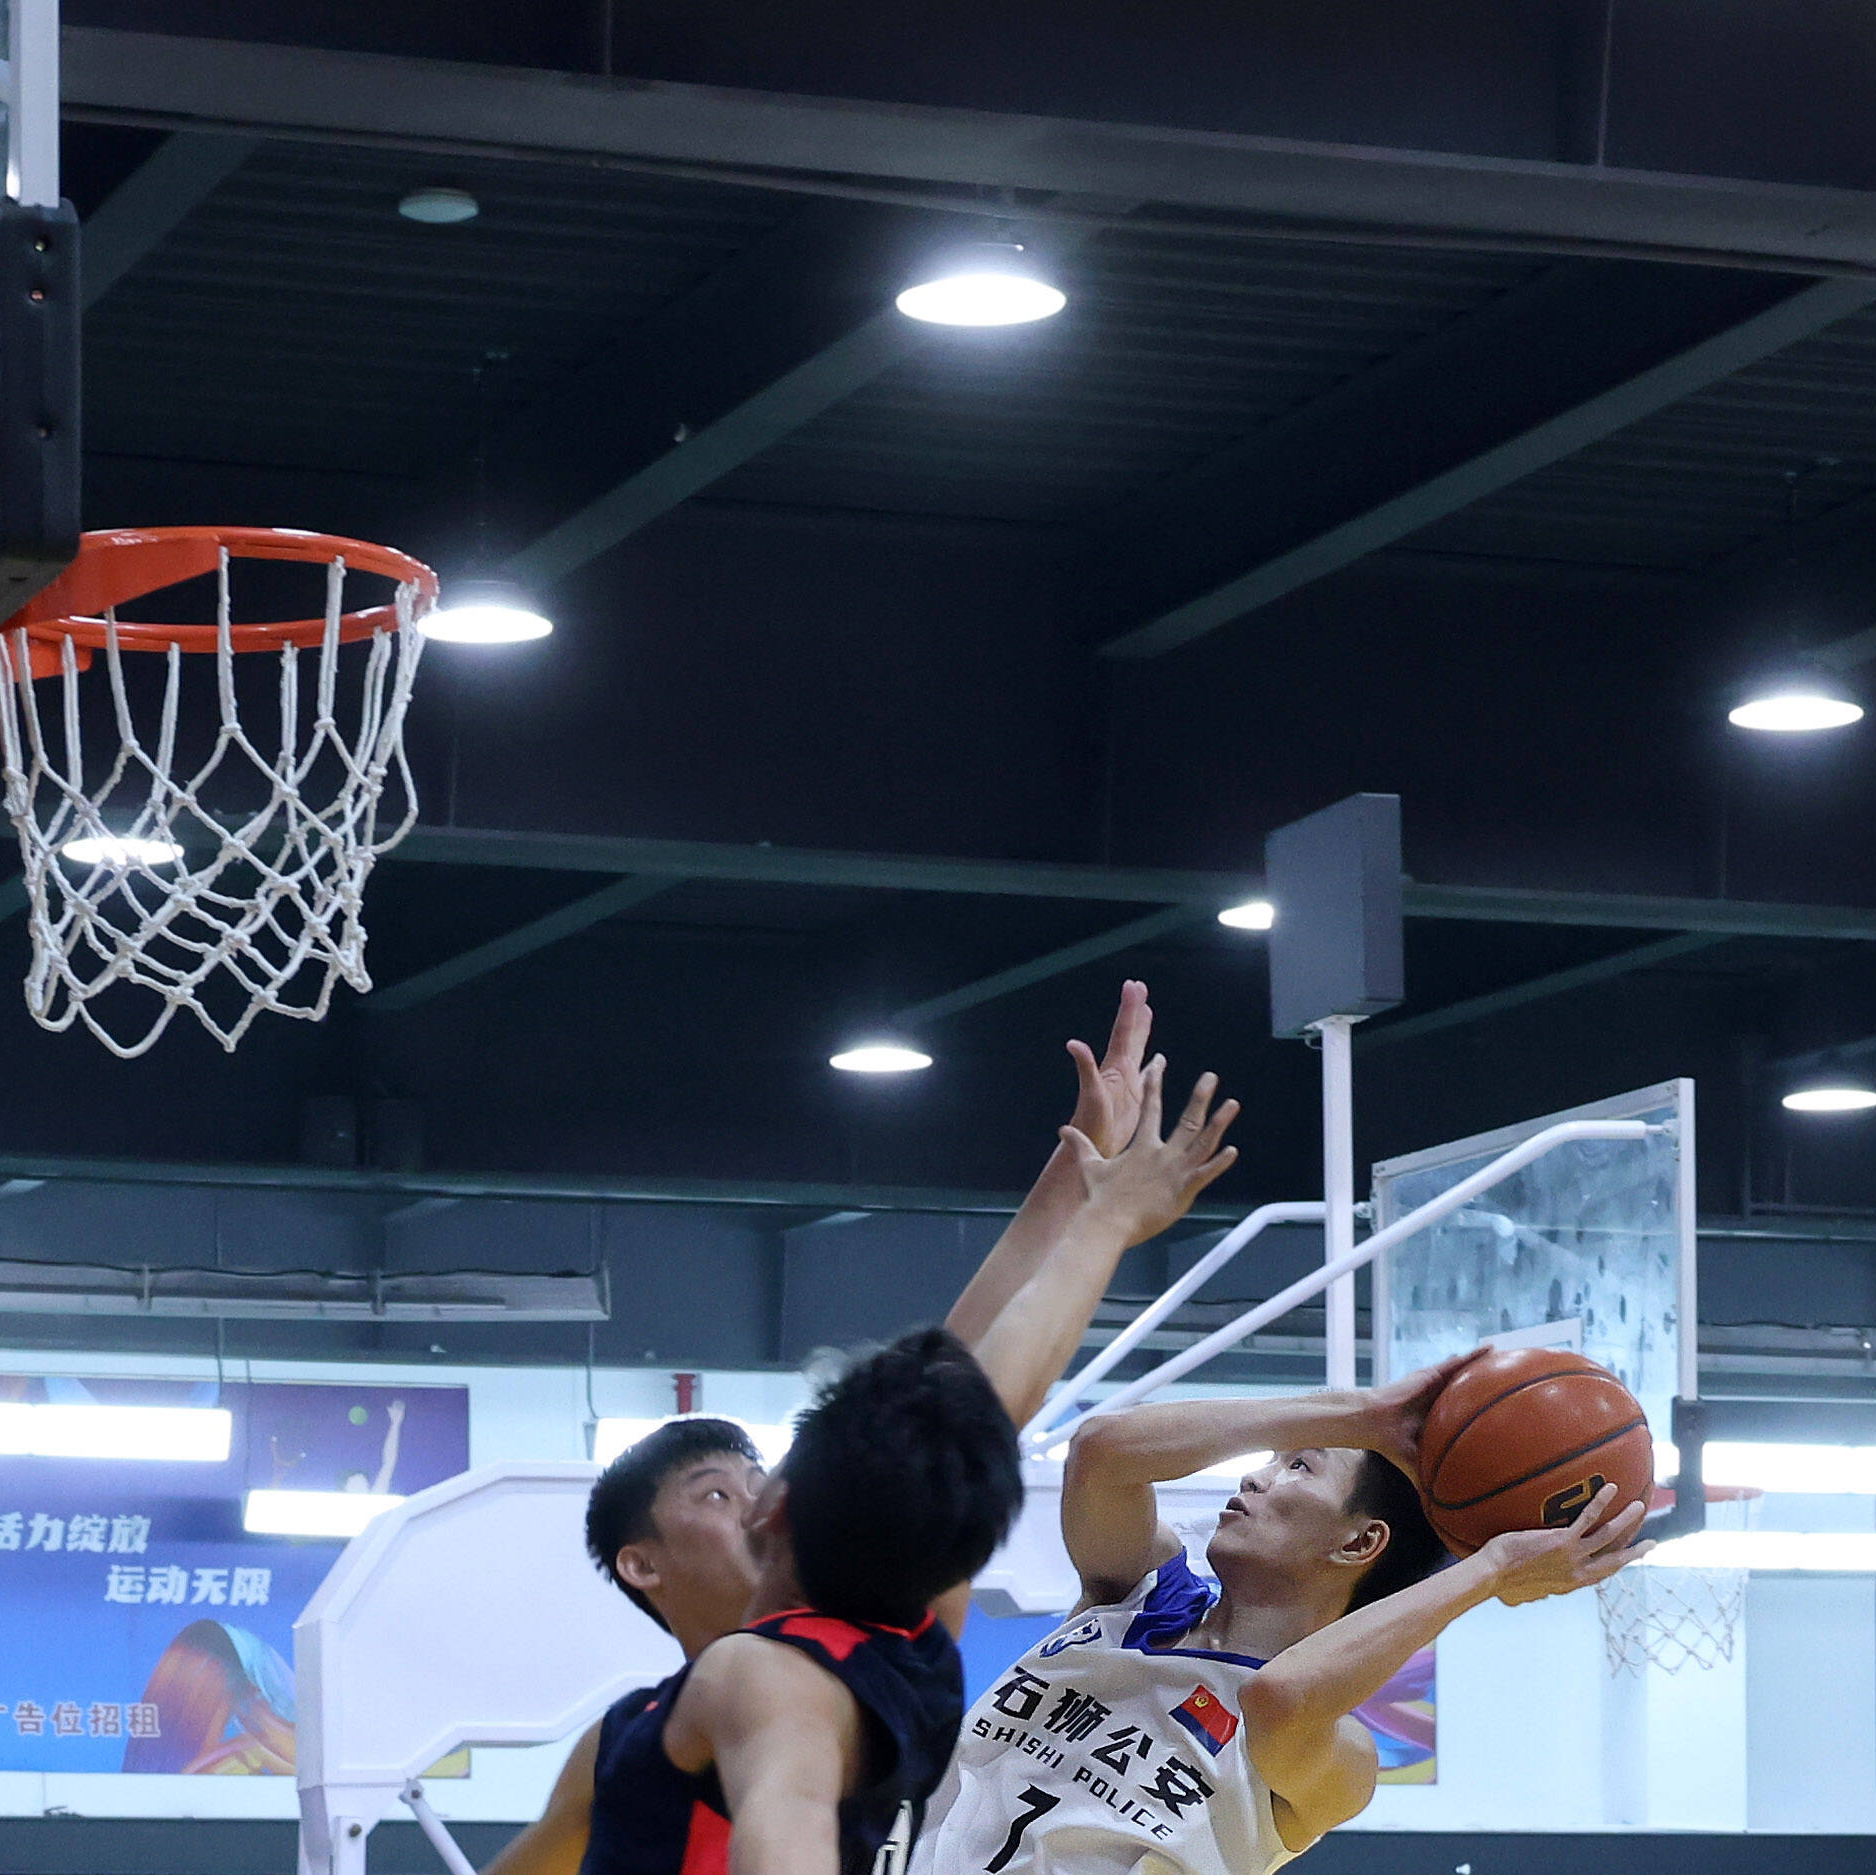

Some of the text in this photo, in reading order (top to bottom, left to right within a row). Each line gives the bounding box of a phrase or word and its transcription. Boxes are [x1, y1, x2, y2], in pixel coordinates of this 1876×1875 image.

[105, 1564, 271, 1607] 运动无限
[972, 1718, 1174, 1840] SHISHI POLICE
[993, 1666, 1215, 1820] 石狮公安
[983, 1783, 1061, 1874] 7
